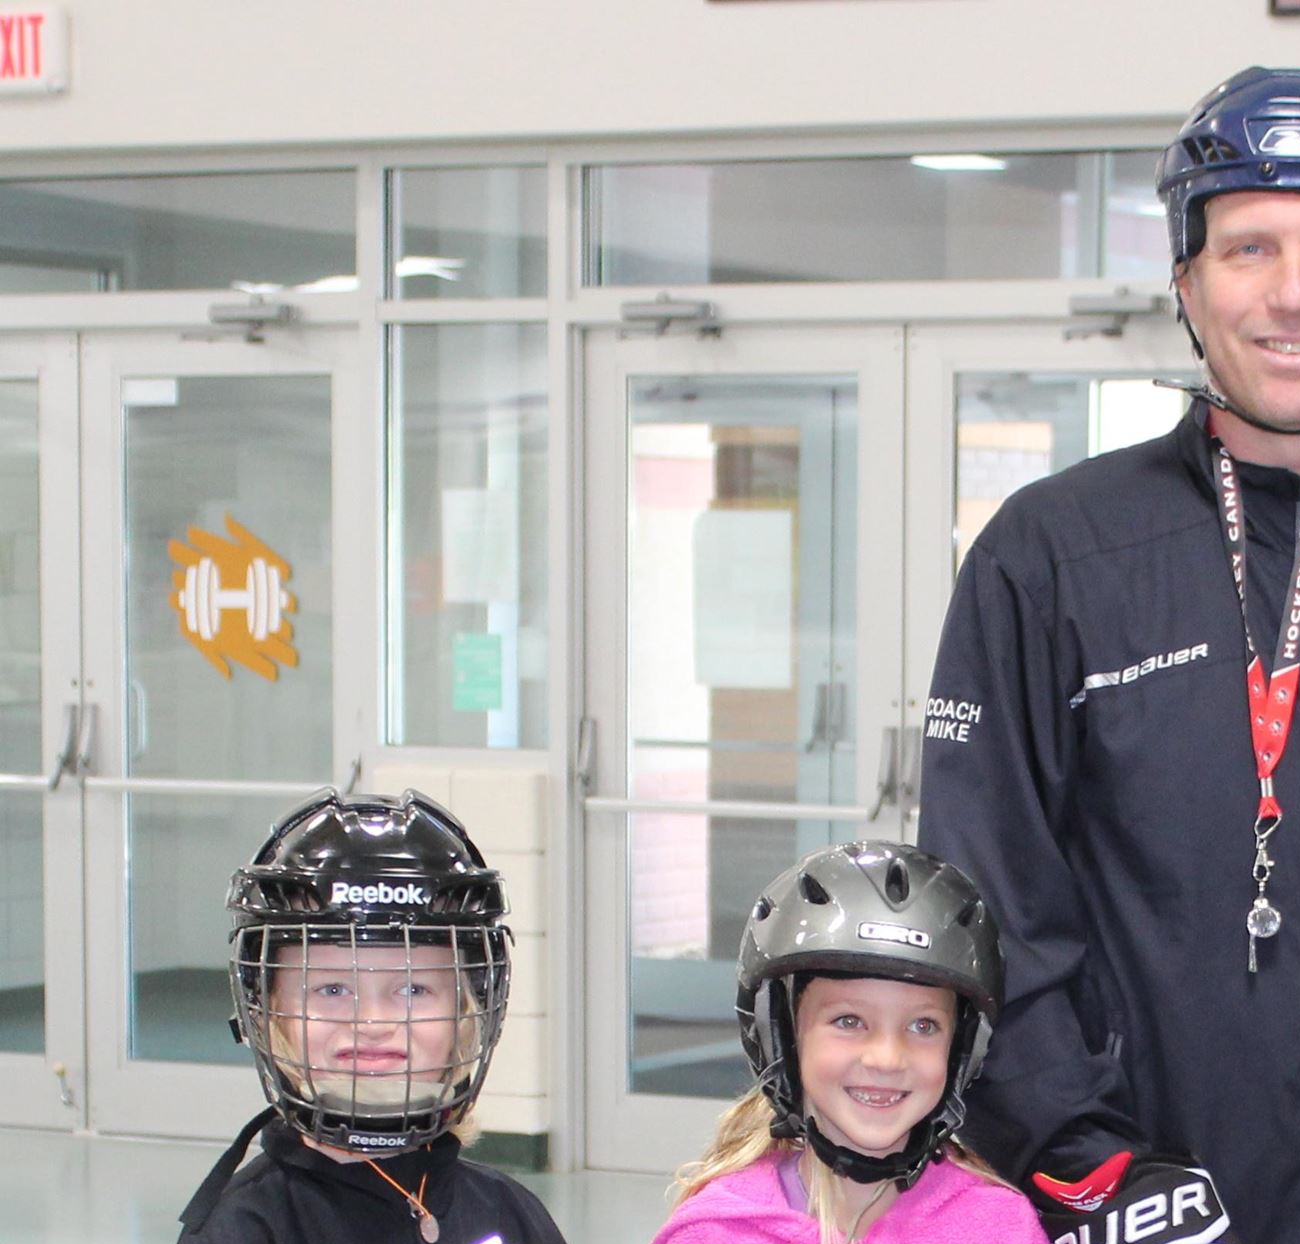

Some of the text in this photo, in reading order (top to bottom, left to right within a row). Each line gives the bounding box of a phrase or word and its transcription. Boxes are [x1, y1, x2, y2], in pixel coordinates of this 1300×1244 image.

[0, 15, 44, 78] XIT
[1121, 643, 1209, 684] BAUER
[926, 697, 982, 724] COACH
[926, 719, 970, 743] MIKE
[331, 881, 424, 905] Reebok
[348, 1133, 407, 1147] Reebok
